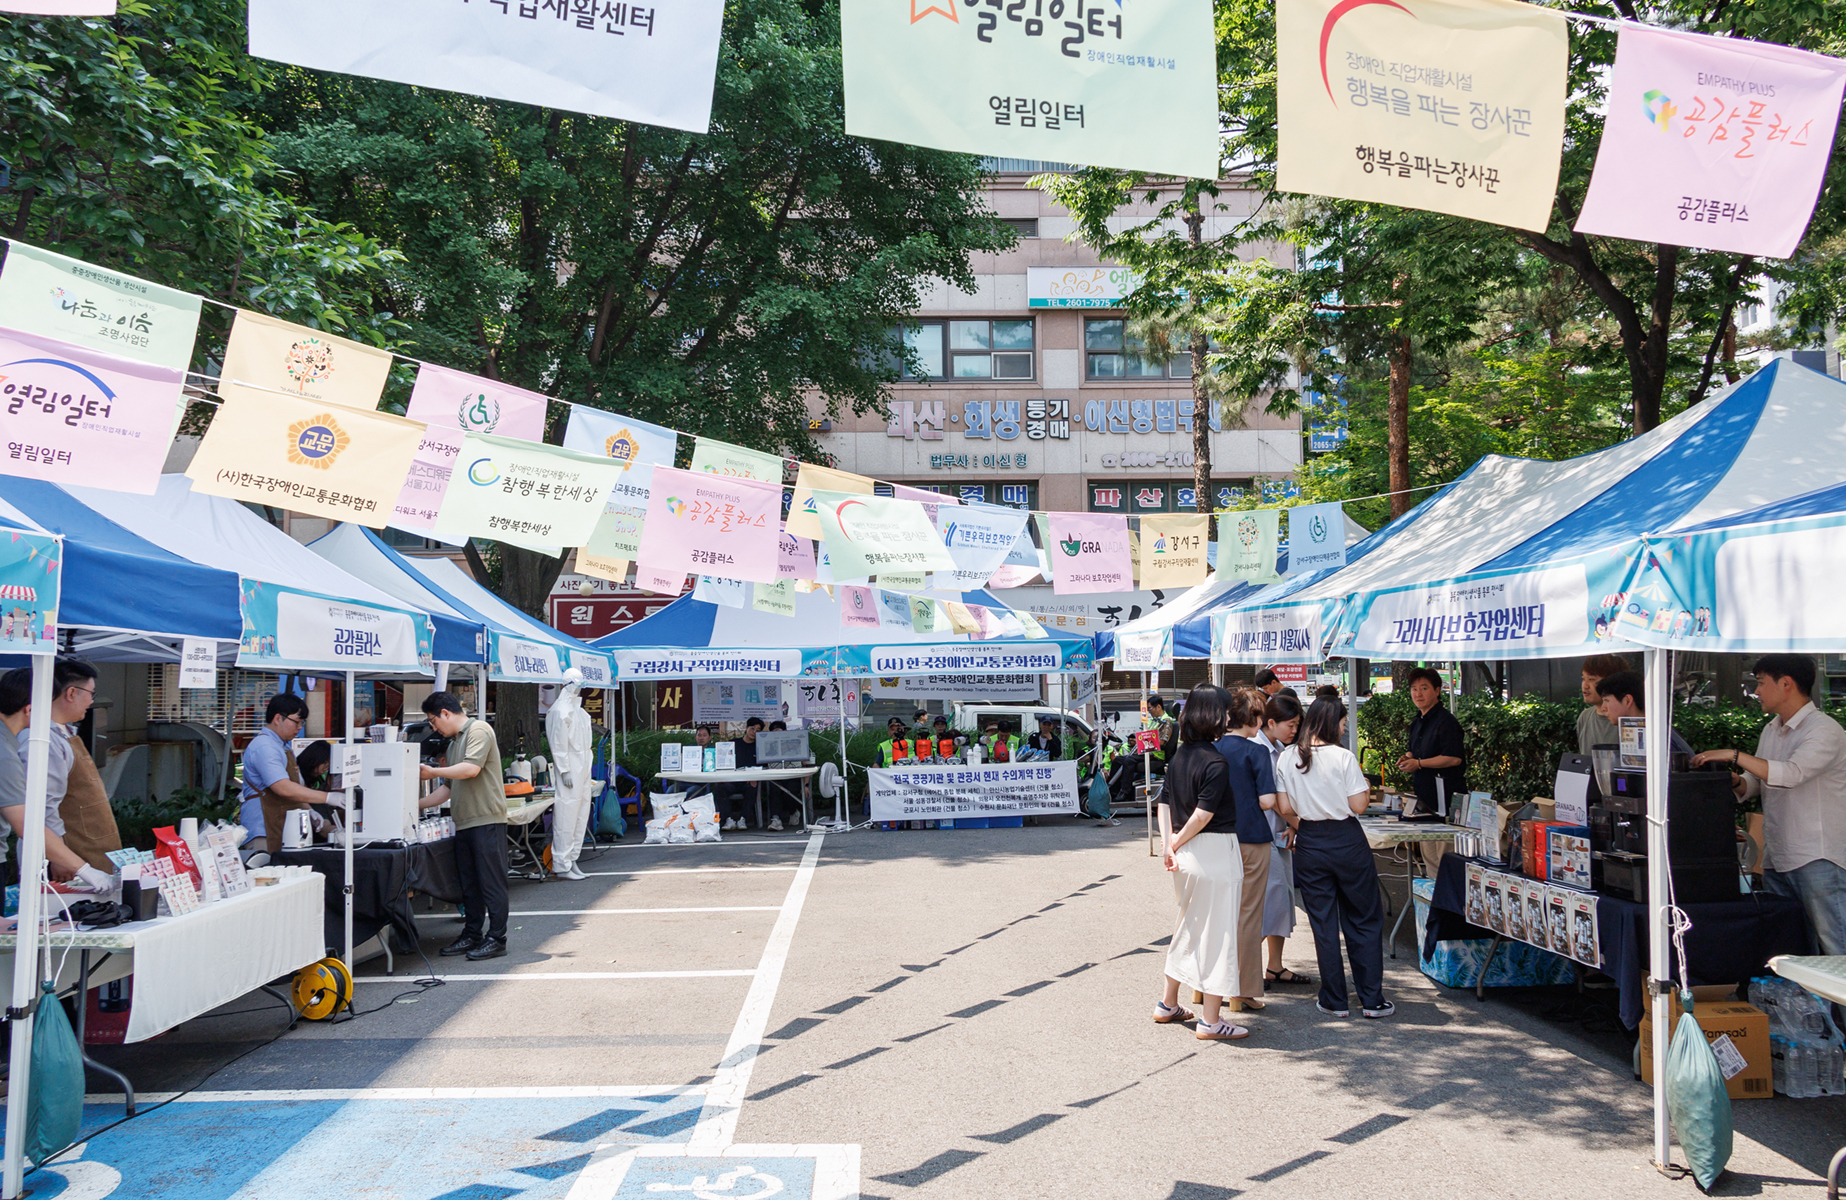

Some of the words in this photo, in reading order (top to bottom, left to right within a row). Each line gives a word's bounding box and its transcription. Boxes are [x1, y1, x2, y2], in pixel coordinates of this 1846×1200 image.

[1087, 49, 1176, 70] 장애인직업재활시설
[1346, 51, 1386, 77] 장애인
[1389, 62, 1473, 92] 직업재활시설
[1697, 72, 1746, 92] EMPATHY
[1749, 81, 1776, 97] PLUS
[989, 95, 1085, 130] 열림일터
[1346, 77, 1411, 117] 행복을
[1417, 93, 1461, 127] 파는
[1468, 101, 1532, 137] 장사꾼
[1683, 95, 1814, 159] 공감플러스
[1355, 145, 1501, 194] 행복을파는장사꾼
[1677, 196, 1750, 224] 공감플러스
[1066, 299, 1111, 307] 2601-7975
[98, 326, 150, 348] 조명사업단
[4, 384, 111, 427] 열림일터
[1026, 400, 1070, 420] 등기
[808, 419, 822, 430] 2F
[1026, 420, 1071, 440] 경매
[299, 430, 334, 453] 교문
[612, 442, 631, 459] 교문
[8, 442, 72, 465] 열림일터
[931, 454, 969, 468] 법무사
[216, 468, 378, 512] (사)한국장애인교통문화협회
[404, 478, 442, 492] 서울지사
[696, 488, 725, 501] EMPATHY
[725, 493, 740, 504] PLUS
[488, 516, 552, 536] 참행복한세상
[690, 501, 766, 532] 공감플러스
[1082, 541, 1125, 554] GRANADA
[1170, 535, 1200, 551] 강서구
[691, 550, 735, 564] 공감플러스
[865, 552, 928, 565] 행복을파는장사꾼
[1070, 574, 1091, 582] 그라나다
[1385, 603, 1546, 645] 그라나다보호작업센터
[334, 628, 383, 656] 공감플러스
[1229, 630, 1277, 654] (사)에스디워크
[1279, 628, 1310, 652] 서울지사
[630, 659, 781, 674] 구립강서구직업재활센터
[929, 674, 1034, 684] 한국장애인교통문화협회
[912, 773, 944, 785] 공공기관
[946, 773, 955, 784] 및
[957, 771, 981, 783] 관공서
[983, 771, 1000, 782] 현재
[1002, 769, 1034, 781] 수의계약
[1555, 801, 1576, 812] GRANADA
